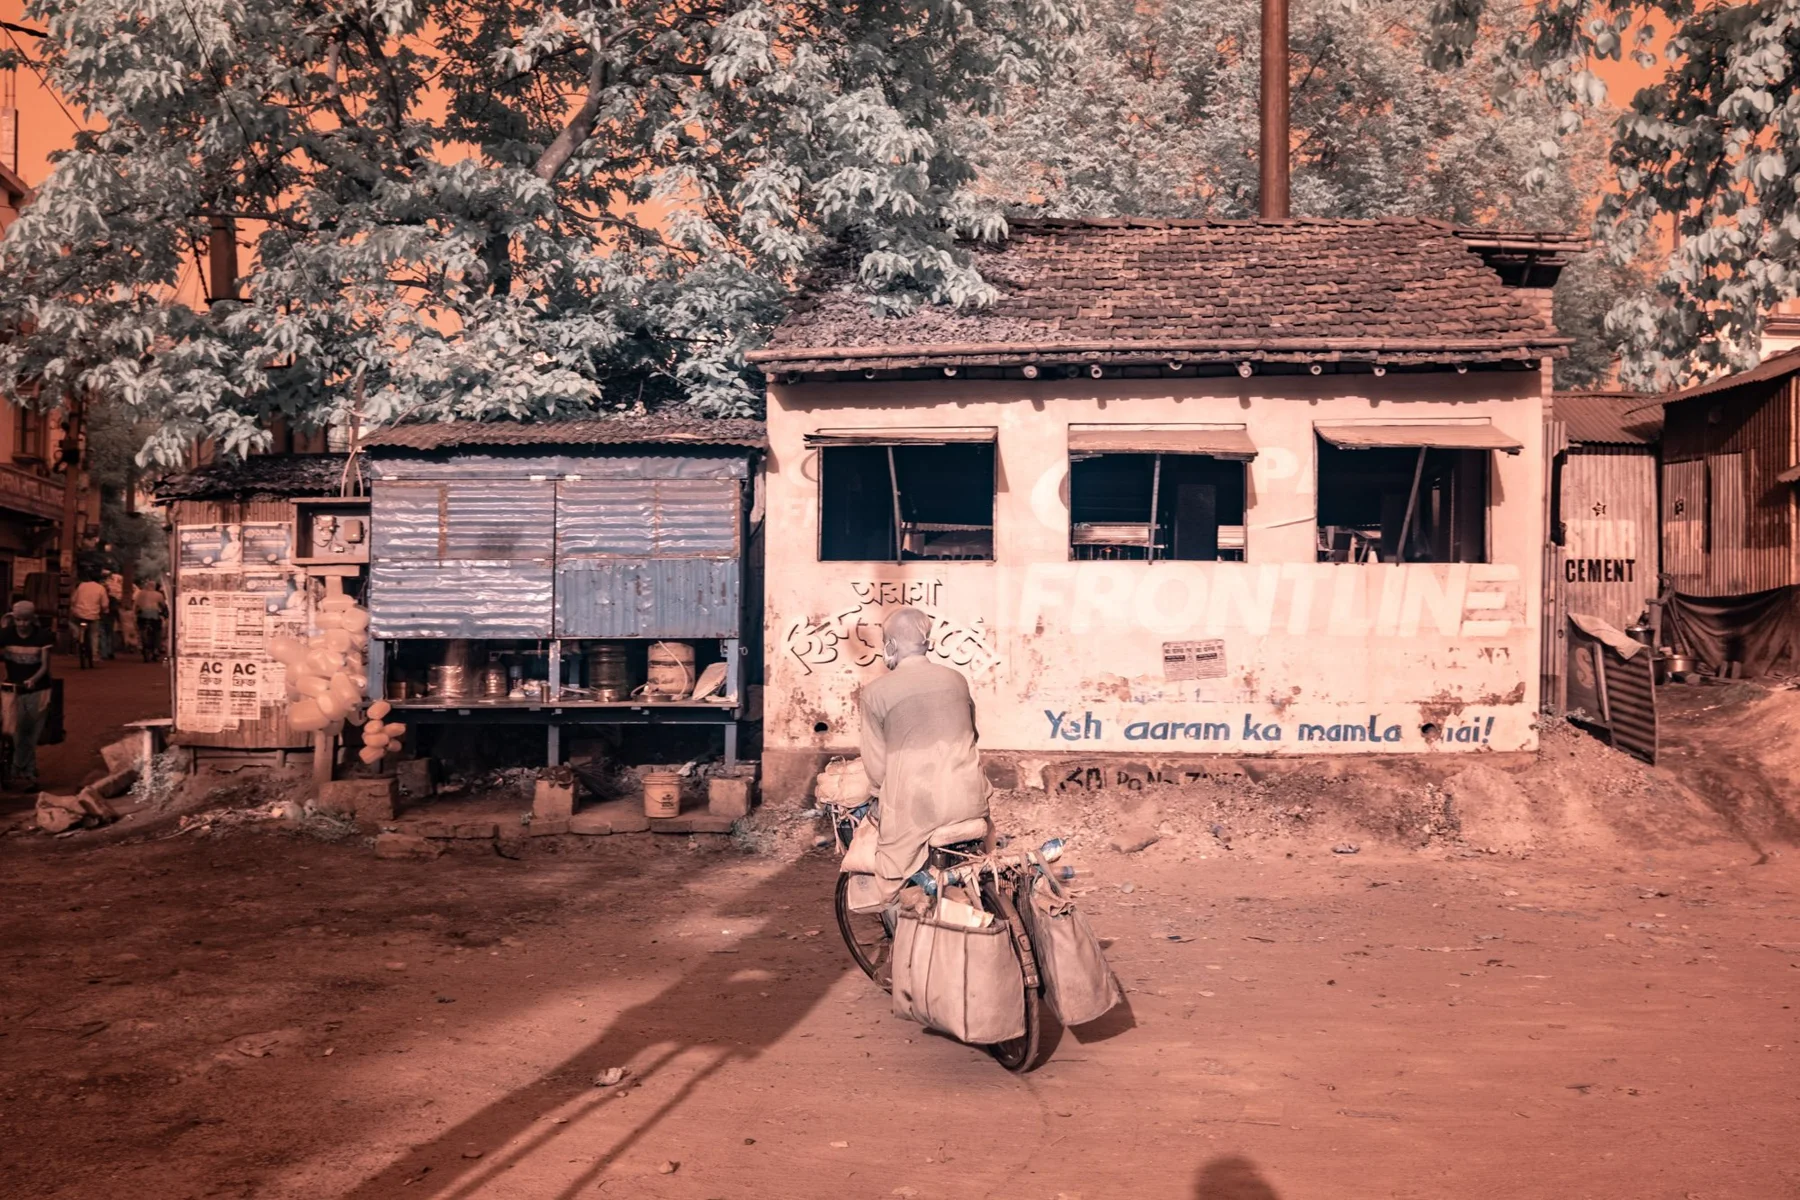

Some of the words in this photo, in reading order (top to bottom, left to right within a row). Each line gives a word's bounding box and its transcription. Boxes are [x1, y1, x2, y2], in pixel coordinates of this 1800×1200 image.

[1565, 559, 1635, 583] CEMENT
[1018, 561, 1521, 638] FRONTLINE
[200, 662, 223, 674] AC
[233, 663, 257, 675] AC
[1044, 710, 1102, 741] Yeh
[1124, 722, 1231, 741] aaram
[1243, 713, 1281, 741] ka
[1297, 715, 1402, 742] mamla
